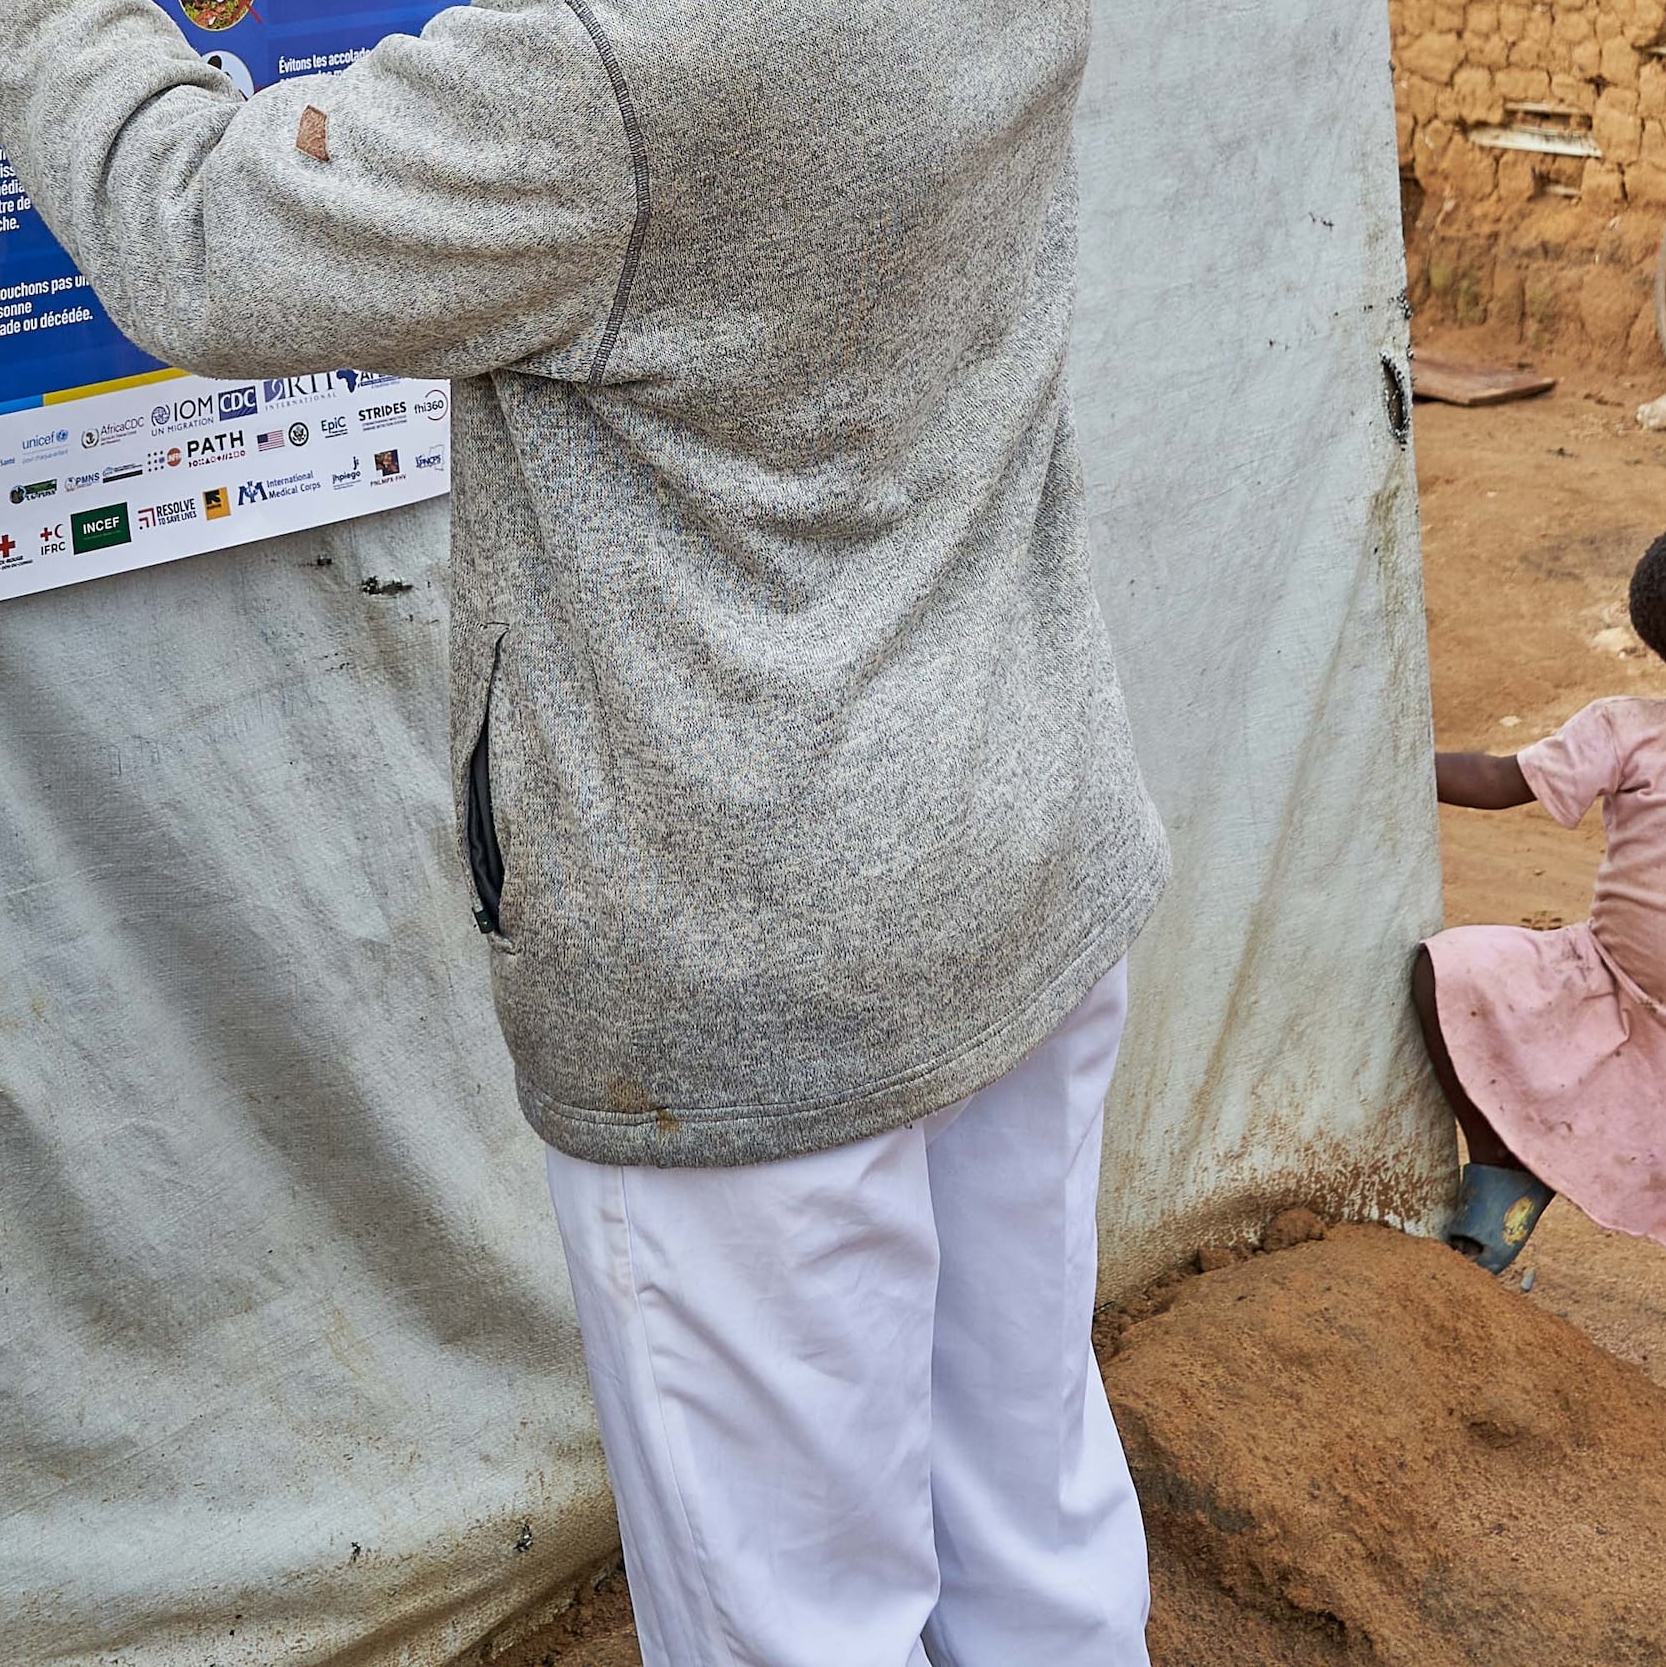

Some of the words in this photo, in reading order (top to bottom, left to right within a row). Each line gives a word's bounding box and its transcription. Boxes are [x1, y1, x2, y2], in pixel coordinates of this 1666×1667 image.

[279, 55, 312, 74] Évitons
[313, 53, 328, 68] les
[17, 196, 31, 211] de
[51, 276, 73, 294] pas
[23, 317, 38, 331] ou
[40, 306, 93, 328] décédée.
[174, 395, 213, 422] IOM
[219, 389, 256, 413] CDC
[265, 393, 337, 411] INTERNATIONAL
[414, 399, 444, 415] fhi360
[358, 401, 407, 422] STRIDES
[151, 427, 164, 437] UN
[167, 417, 214, 434] MIGRATION
[321, 416, 346, 434] EpiC
[22, 431, 55, 450] unicef
[187, 430, 244, 458] PATH
[76, 472, 100, 485] PMNS
[267, 470, 314, 488] International
[269, 487, 299, 499] Medical
[300, 481, 321, 495] Corps
[156, 498, 196, 517] RESOLVE
[83, 516, 120, 534] INCEF
[158, 517, 166, 526] TO
[166, 514, 181, 524] SAVE
[182, 511, 197, 522] LIVES
[40, 541, 66, 556] IFRC
